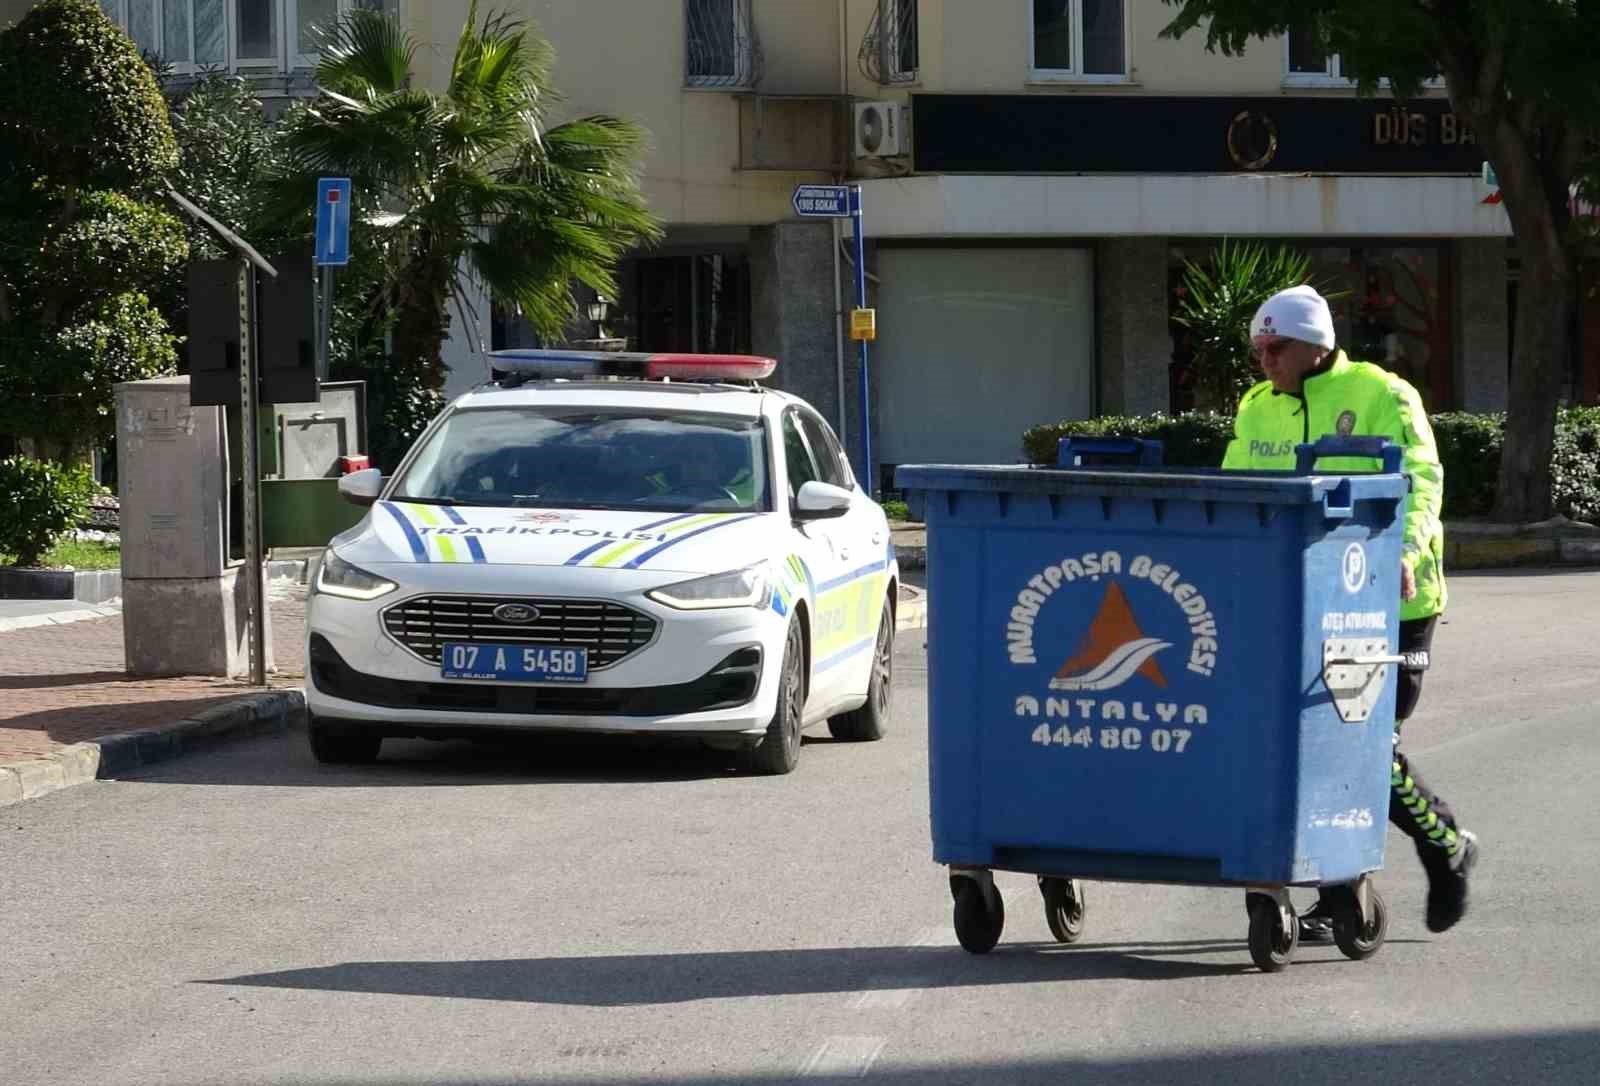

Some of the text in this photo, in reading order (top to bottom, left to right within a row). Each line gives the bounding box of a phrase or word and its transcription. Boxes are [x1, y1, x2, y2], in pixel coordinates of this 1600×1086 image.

[418, 525, 542, 536] TRAFİK
[503, 607, 529, 619] Ford
[452, 646, 478, 670] 07
[495, 648, 506, 671] A
[523, 649, 576, 673] 5458
[1015, 695, 1208, 724] ANTALYA
[1031, 723, 1093, 748] 444
[1151, 728, 1192, 752] 07
